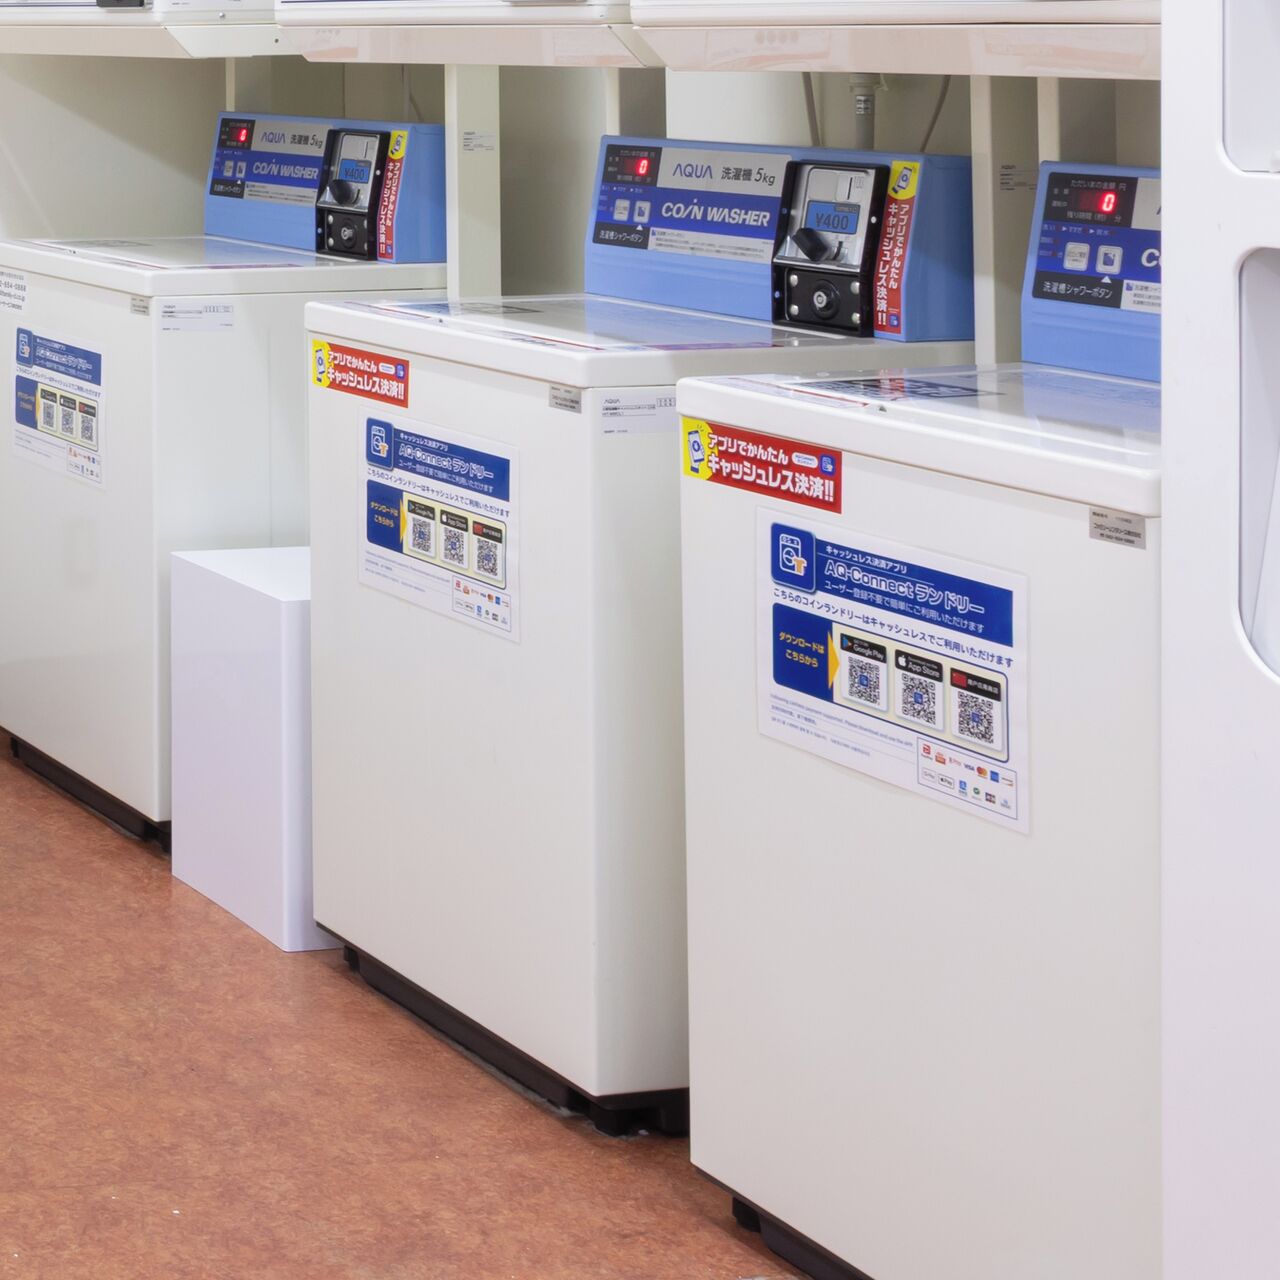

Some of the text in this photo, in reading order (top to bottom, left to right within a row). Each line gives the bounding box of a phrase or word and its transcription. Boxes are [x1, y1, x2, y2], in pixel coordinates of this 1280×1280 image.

[260, 132, 286, 145] AQUA
[309, 134, 323, 149] 5kg
[279, 164, 319, 180] WASHER
[344, 167, 365, 181] ¥400
[639, 159, 648, 175] 0
[673, 163, 776, 187] AQUA 洗濯機 5kg
[1070, 179, 1127, 191] ただいまの金額 円
[1102, 192, 1116, 213] 0
[706, 206, 771, 228] WASHER
[815, 211, 851, 232] ¥400
[599, 230, 644, 243] 洗濯槽シャワーボタン
[888, 203, 911, 290] アプリでかんたん
[876, 202, 900, 327] キャッシュレス決済!!
[1042, 280, 1113, 300] 洗濯槽シャワーボタン
[328, 351, 377, 373] アプリでかんたん
[327, 366, 405, 400] キャッシュレス決済!!
[708, 434, 789, 465] アプリでかんたん
[399, 443, 494, 479] AQ-Connect ランドリー
[708, 454, 835, 502] キャッシュレス決済!!
[825, 545, 907, 574] キャッシュレス決済アプリ
[824, 560, 985, 615] AQ-Connect ランドリー
[824, 580, 985, 634] ユーザー登録不要で簡単にご利用いただけます
[773, 587, 1014, 668] こちらのコインランドリーはキャッシュレスでご利用いただけます
[779, 631, 825, 655] ダウンロードは
[853, 643, 884, 661] Google Play
[785, 649, 819, 669] こちらから
[908, 662, 940, 678] App Store
